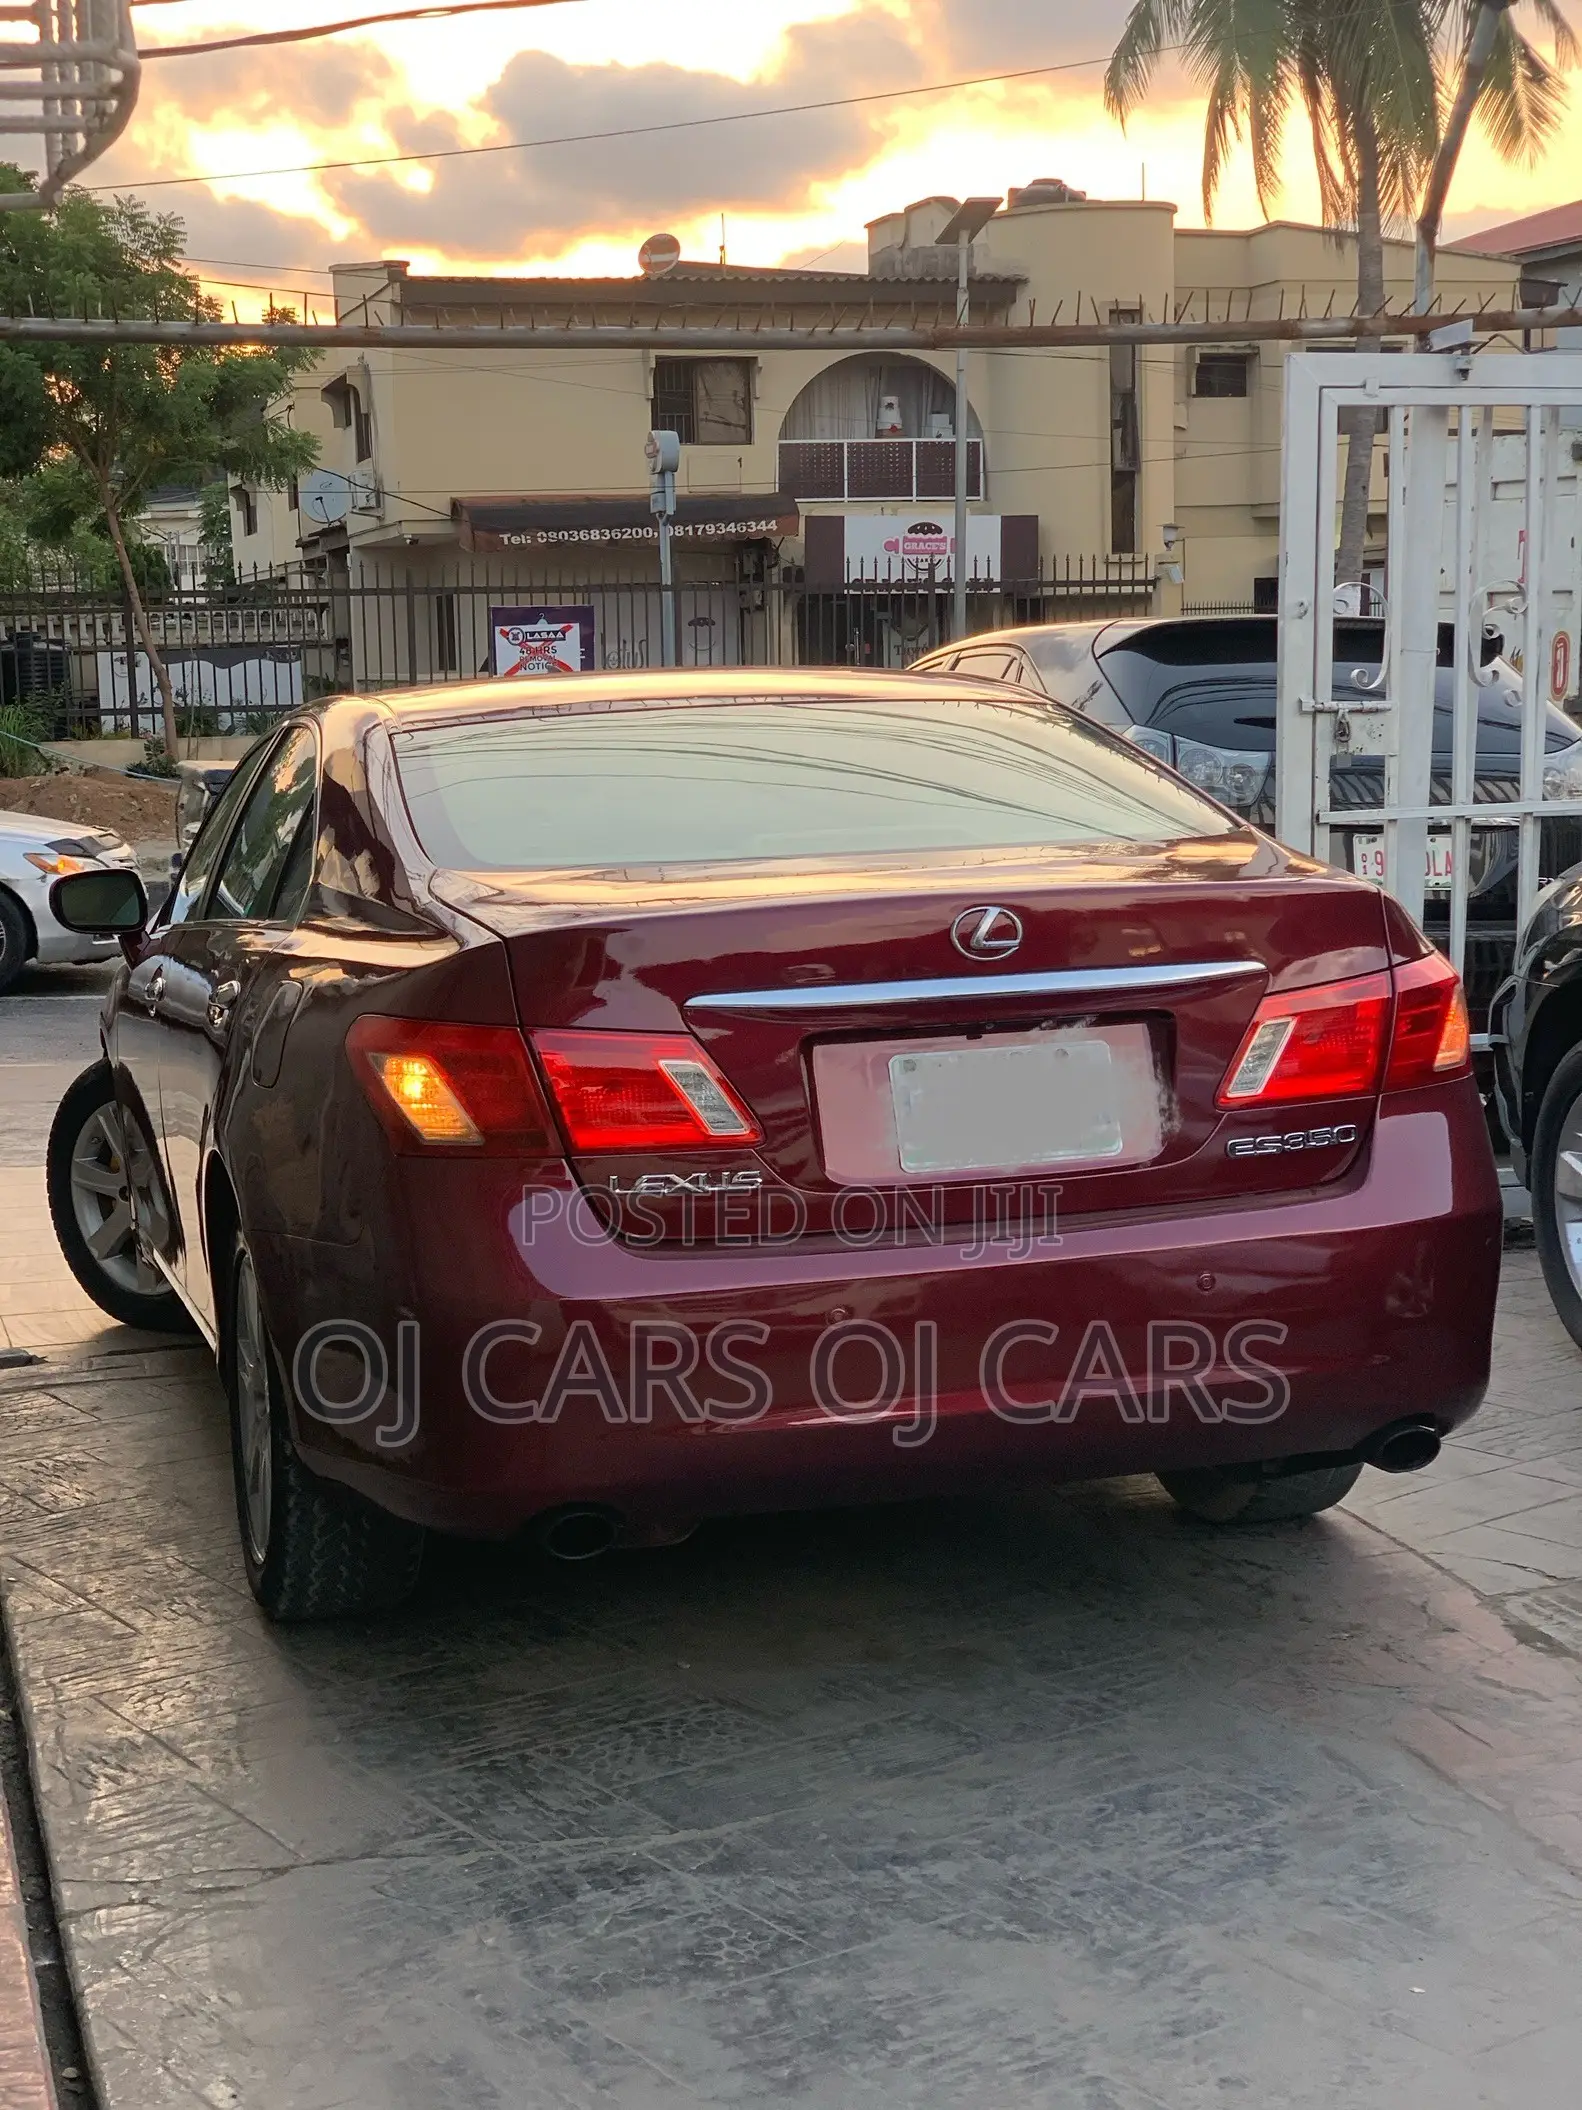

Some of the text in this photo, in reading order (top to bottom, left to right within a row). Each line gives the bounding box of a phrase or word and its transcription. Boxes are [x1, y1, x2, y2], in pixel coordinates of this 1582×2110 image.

[499, 532, 532, 546] Tel:
[903, 541, 946, 550] GRACE'S
[526, 630, 565, 640] LASAA
[519, 645, 558, 656] 48 HRS
[610, 1170, 763, 1194] LEXUS
